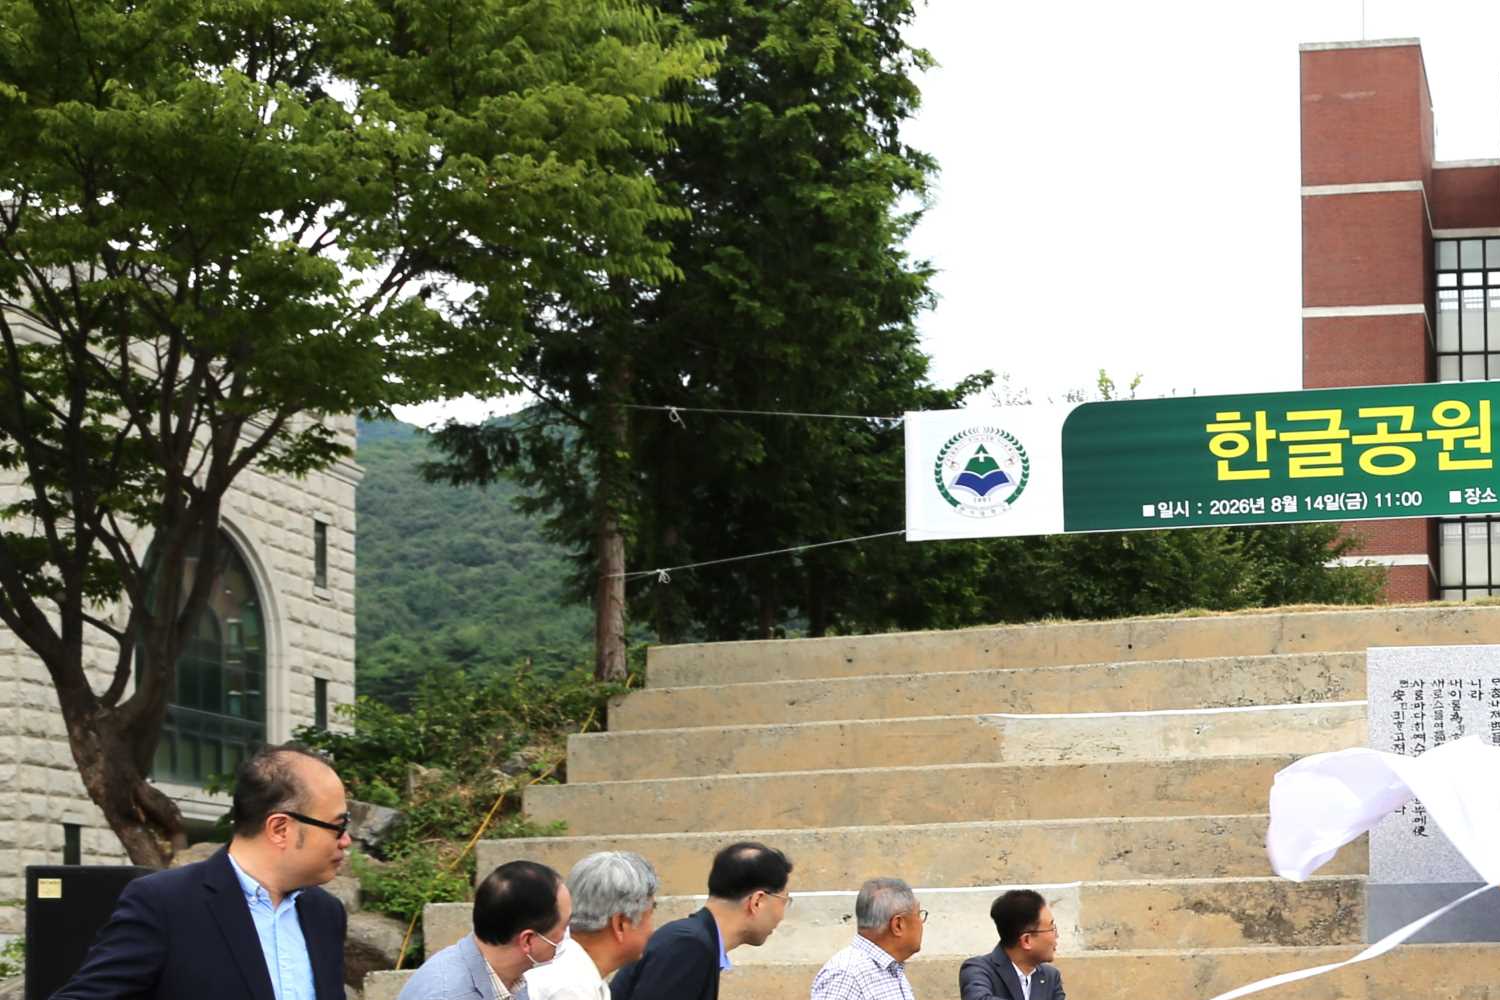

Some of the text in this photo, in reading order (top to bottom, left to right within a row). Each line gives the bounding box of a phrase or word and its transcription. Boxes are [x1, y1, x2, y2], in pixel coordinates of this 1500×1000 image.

[1206, 399, 1493, 481] 한글공원
[1157, 500, 1190, 519] 일시
[1209, 497, 1265, 515] 2026년
[1270, 495, 1298, 513] 8월
[1304, 491, 1368, 511] 14일(금)
[1374, 491, 1423, 507] 11:00
[1464, 487, 1498, 505] 장소
